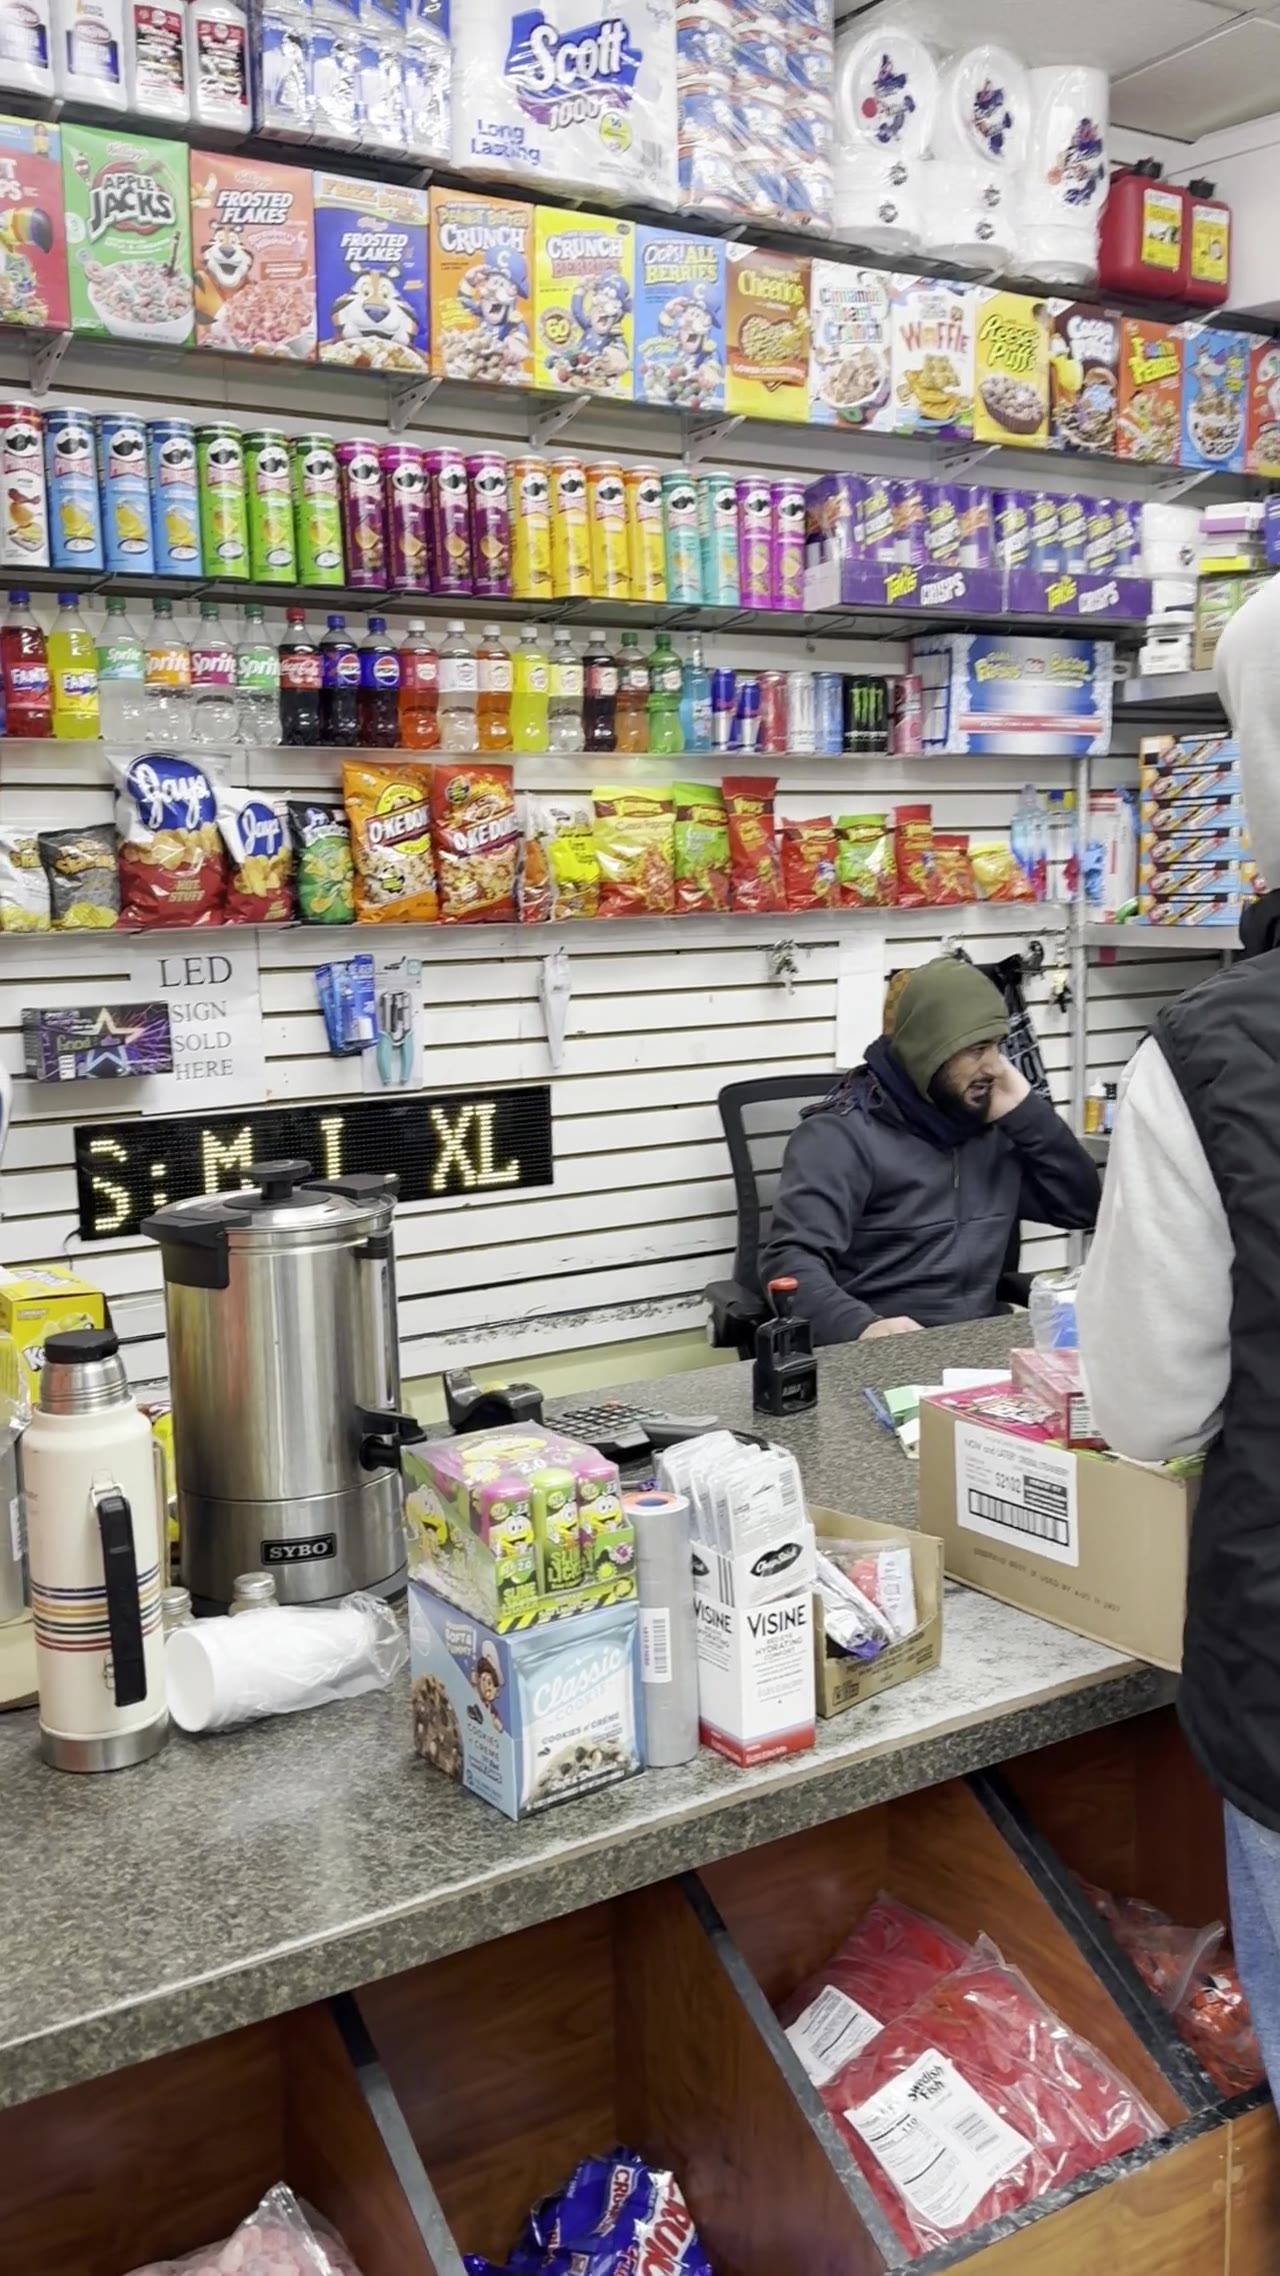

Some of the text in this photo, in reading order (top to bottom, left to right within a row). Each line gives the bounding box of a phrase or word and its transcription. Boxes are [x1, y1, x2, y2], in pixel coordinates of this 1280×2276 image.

[529, 19, 626, 92] Scott
[549, 96, 602, 131] 1000
[477, 118, 525, 145] Long
[471, 138, 541, 165] Lasting
[103, 174, 155, 191] APPLE
[217, 190, 294, 209] FROSTED
[90, 186, 175, 242] JACKS
[222, 207, 289, 225] FLAKES
[340, 232, 409, 249] FROSTED
[438, 224, 526, 252] CRUNCH
[546, 237, 625, 261] CRUNCH
[344, 247, 403, 262] FLAKES
[685, 244, 718, 265] ALL
[644, 264, 718, 284] BERRIES
[107, 648, 141, 662] Sprite
[135, 762, 212, 829] Jays
[167, 889, 206, 903] STUFF
[157, 955, 233, 988] LED
[172, 1000, 228, 1023] SIGN
[173, 1031, 232, 1052] SOLD
[175, 1058, 234, 1081] HERE
[202, 1126, 255, 1194] M
[430, 1103, 521, 1192] XL
[268, 1540, 329, 1561] SYBO
[747, 1603, 808, 1639] VISINE
[755, 1636, 804, 1657] HYDRATING
[533, 1645, 622, 1719] Classic
[541, 1726, 582, 1745] COOKIES
[906, 2064, 945, 2102] Swedish
[919, 2079, 946, 2101] Fish
